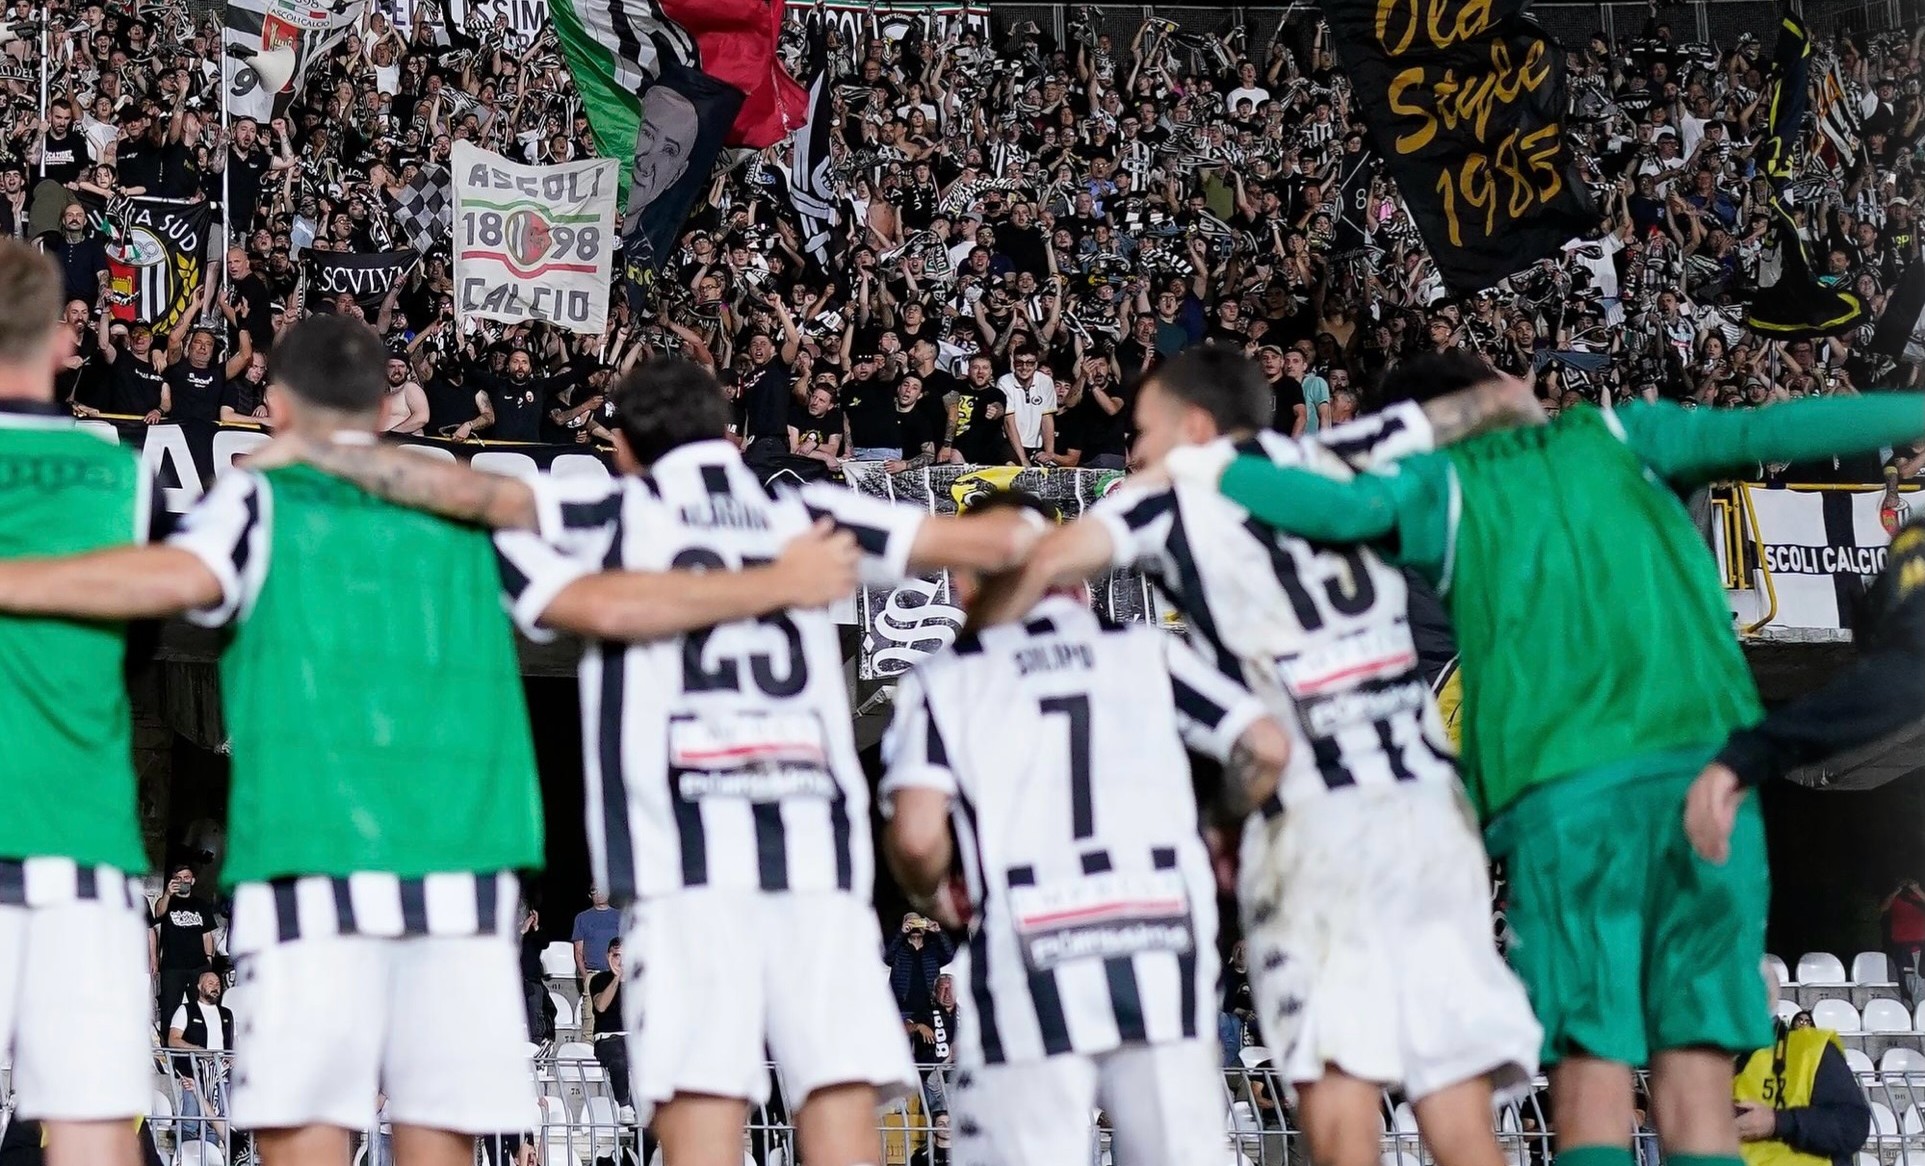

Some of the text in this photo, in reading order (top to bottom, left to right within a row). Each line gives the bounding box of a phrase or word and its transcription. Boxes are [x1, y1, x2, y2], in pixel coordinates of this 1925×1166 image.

[1388, 38, 1550, 154] Style
[468, 163, 604, 203] ASCOLI
[1436, 123, 1562, 247] 1985
[159, 214, 198, 251] SUD
[462, 212, 600, 261] 18 98
[316, 265, 403, 295] SCVLV
[462, 278, 589, 321] CALCIO
[1758, 546, 1819, 573] SCOLI
[1822, 546, 1888, 574] CALCIO
[1040, 693, 1093, 840] 7
